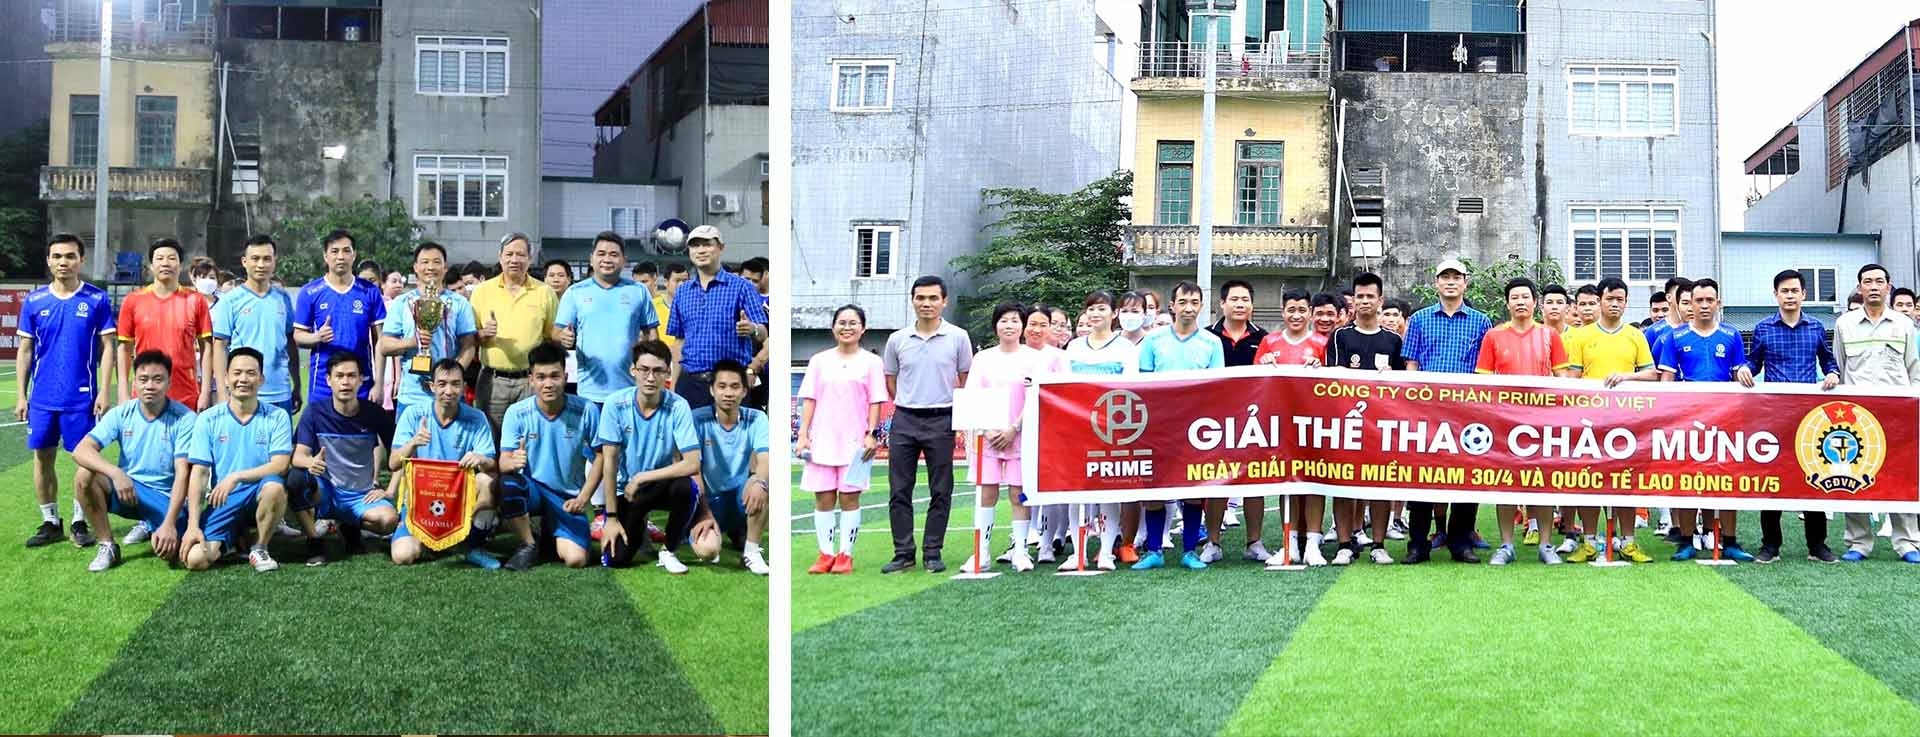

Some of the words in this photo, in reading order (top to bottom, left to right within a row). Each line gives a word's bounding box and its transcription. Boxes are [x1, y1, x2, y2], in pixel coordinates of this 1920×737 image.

[1313, 381, 1370, 398] CÔNG
[1376, 386, 1400, 399] TY
[1498, 391, 1557, 406] PRIME
[1562, 393, 1610, 408] NGÓI
[1615, 396, 1657, 412] VIỆT
[1187, 404, 1279, 451] GIẢI
[1292, 401, 1368, 451] THỂ
[1376, 420, 1494, 456] THAO
[1507, 418, 1637, 460] CHÀO
[1651, 420, 1780, 464] MỪNG
[1086, 460, 1153, 478] PRIME
[1186, 459, 1241, 481] NGÀY
[1247, 456, 1286, 479] GIẢI
[1291, 459, 1355, 481] PHÓNG
[1361, 460, 1412, 482] MIỀN
[1418, 466, 1465, 484] NAM
[1471, 468, 1514, 486] 30/4
[1520, 467, 1545, 488] VÀ
[1551, 466, 1604, 490] QUỐC
[1610, 468, 1634, 489] TẾ
[1638, 473, 1674, 490] LAO
[1680, 472, 1733, 495] ĐỘNG
[1739, 475, 1780, 493] 01/5
[1824, 477, 1857, 489] CĐVN
